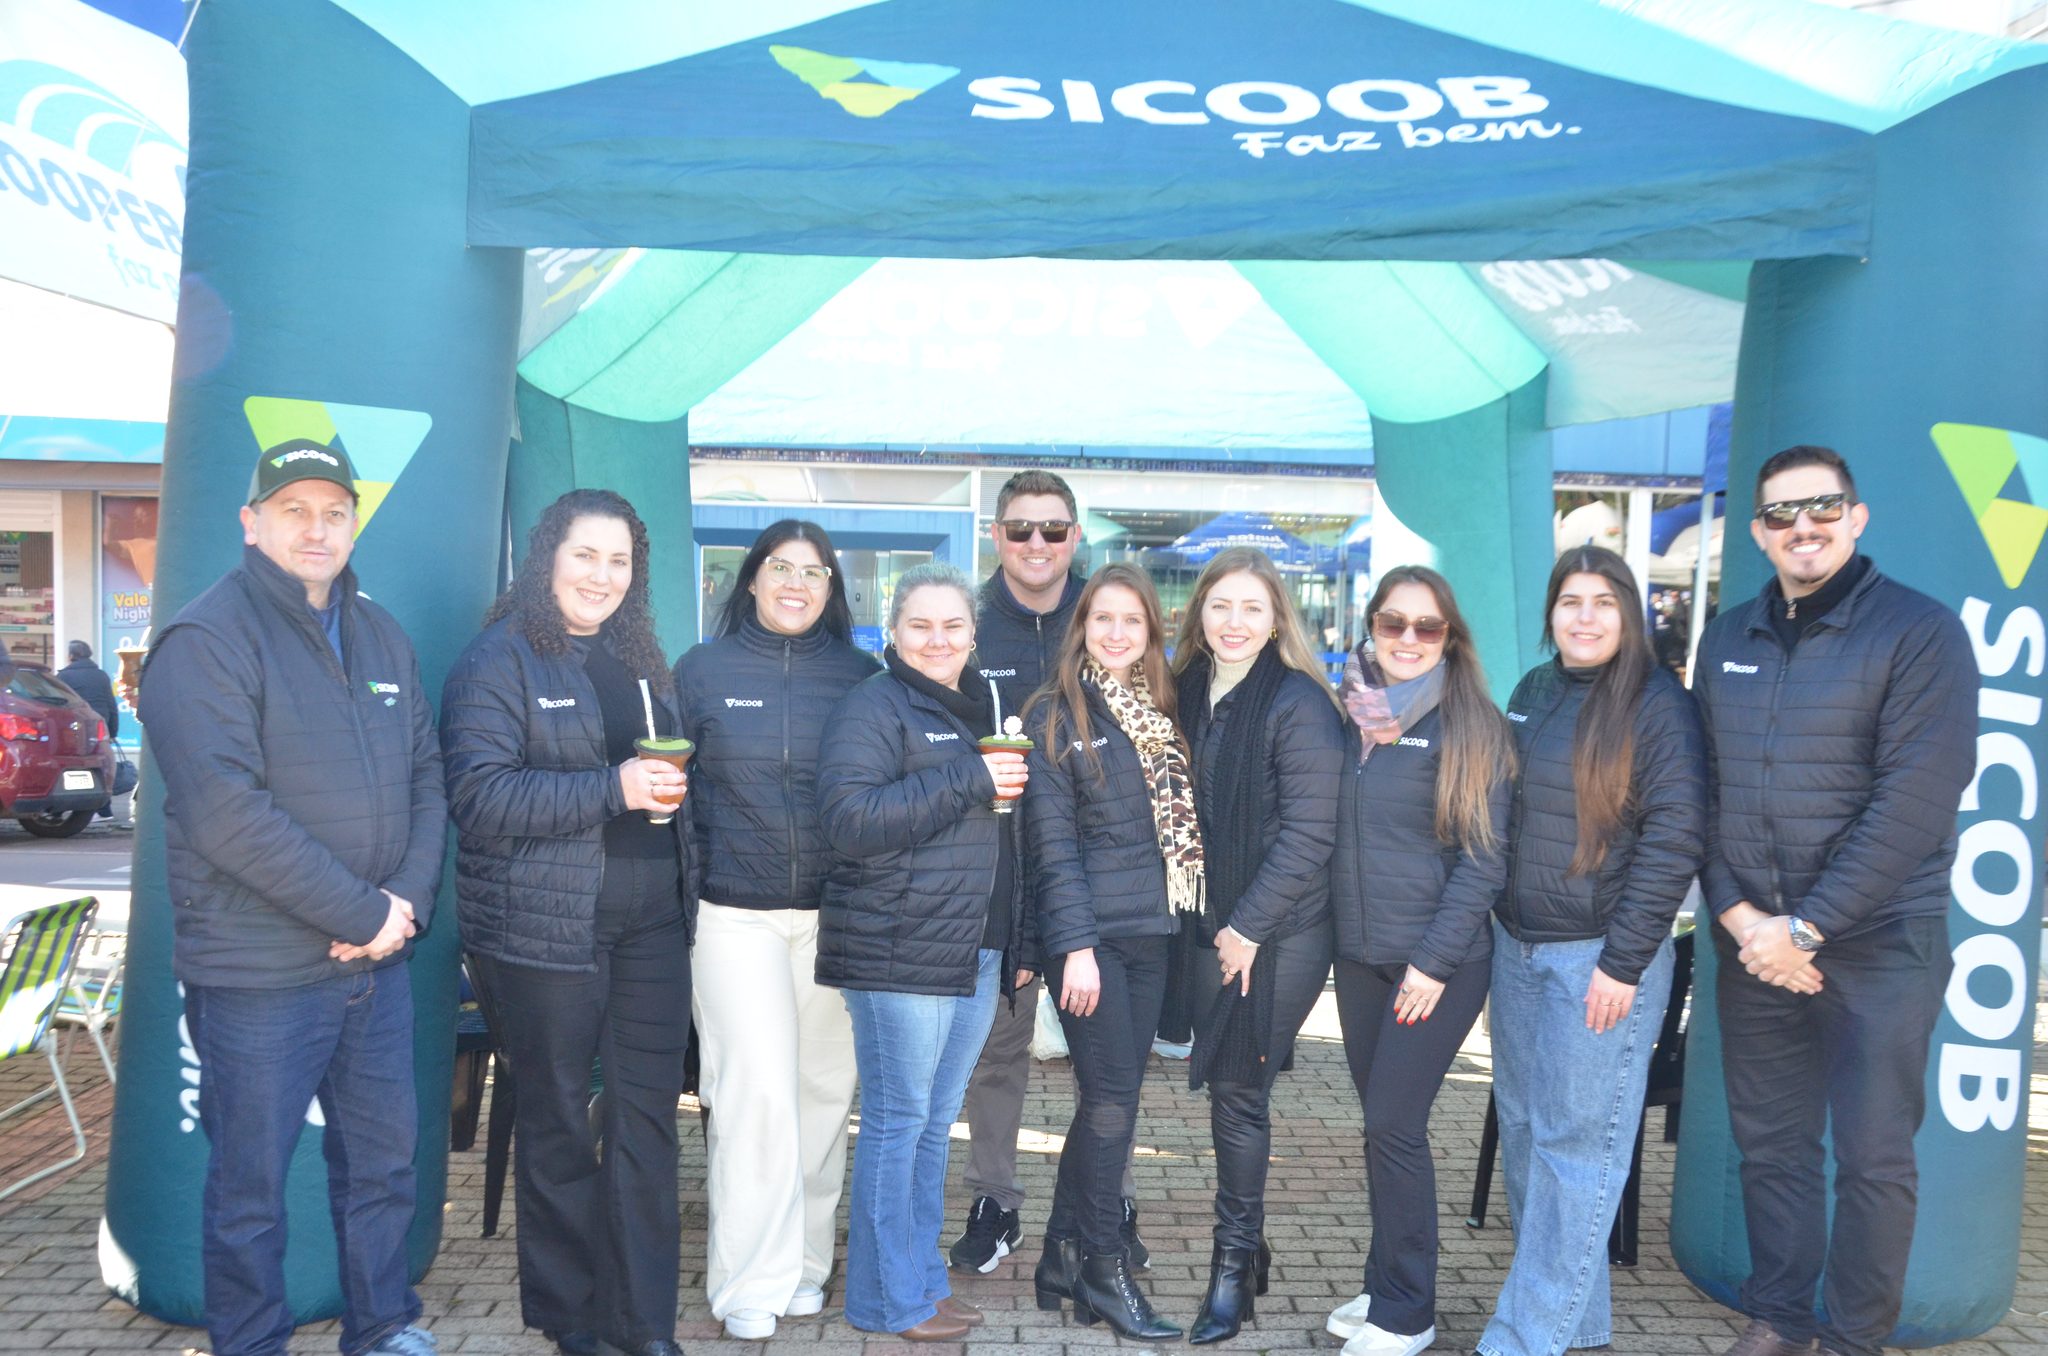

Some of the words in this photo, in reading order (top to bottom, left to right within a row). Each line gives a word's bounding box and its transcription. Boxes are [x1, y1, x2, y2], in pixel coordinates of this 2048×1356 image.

[968, 76, 1549, 124] SICOOB
[1232, 131, 1382, 158] Faz
[1398, 116, 1582, 148] bem.
[0, 139, 184, 256] OOPER
[113, 592, 149, 608] Vale
[989, 668, 1016, 677] SICOOB
[734, 699, 763, 707] SICOOB
[1399, 737, 1429, 748] SICOOB
[1938, 597, 2046, 1132] SICOOB
